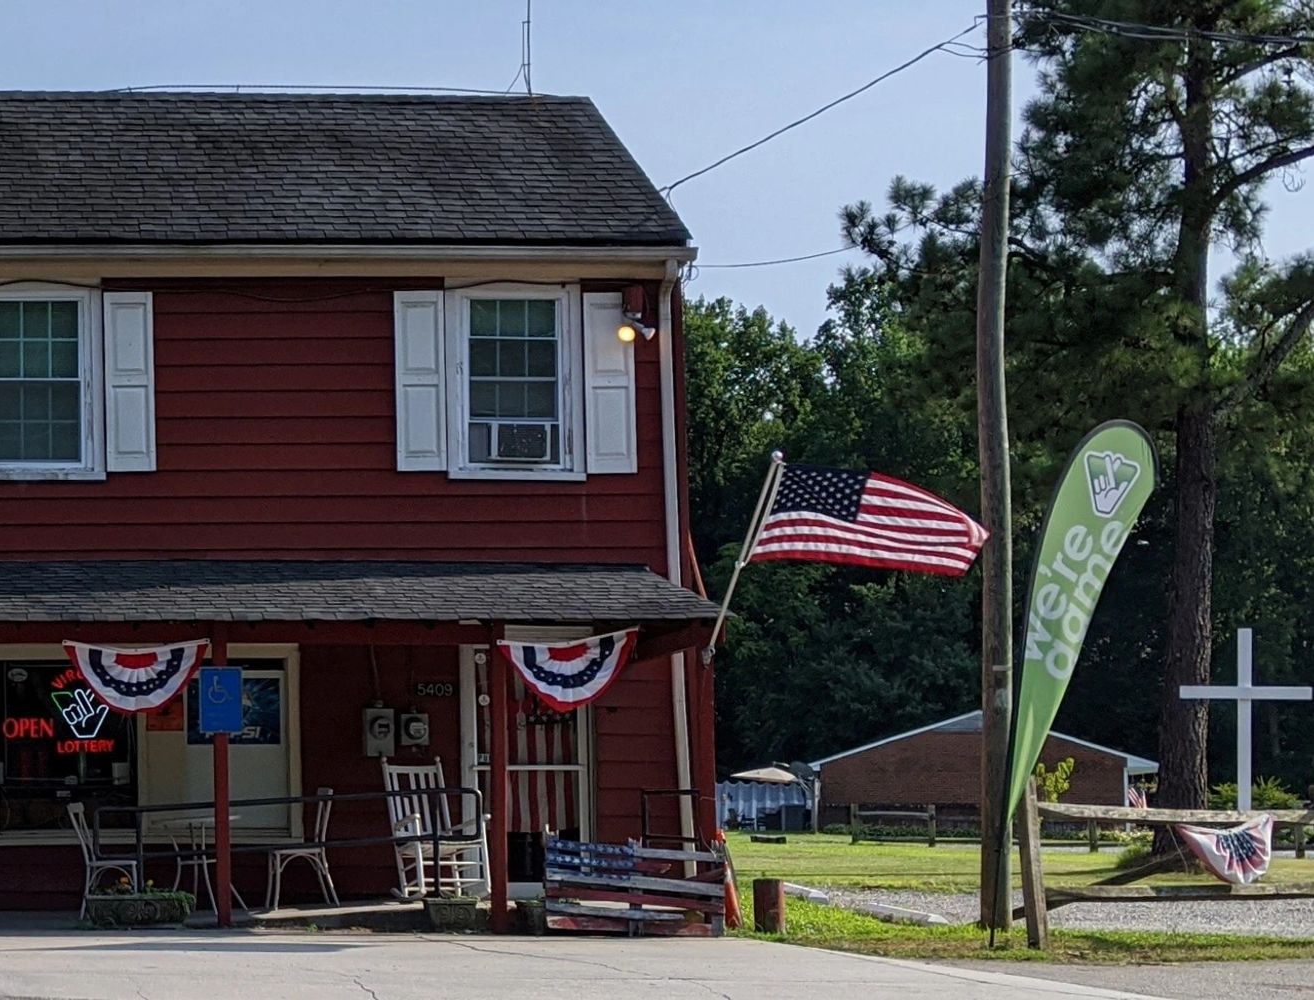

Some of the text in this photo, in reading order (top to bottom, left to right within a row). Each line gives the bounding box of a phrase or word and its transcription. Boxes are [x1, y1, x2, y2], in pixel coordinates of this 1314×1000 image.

[1025, 524, 1093, 661] we're
[417, 684, 453, 696] 5409
[3, 718, 53, 738] OPEN
[57, 740, 114, 752] LOTTERY
